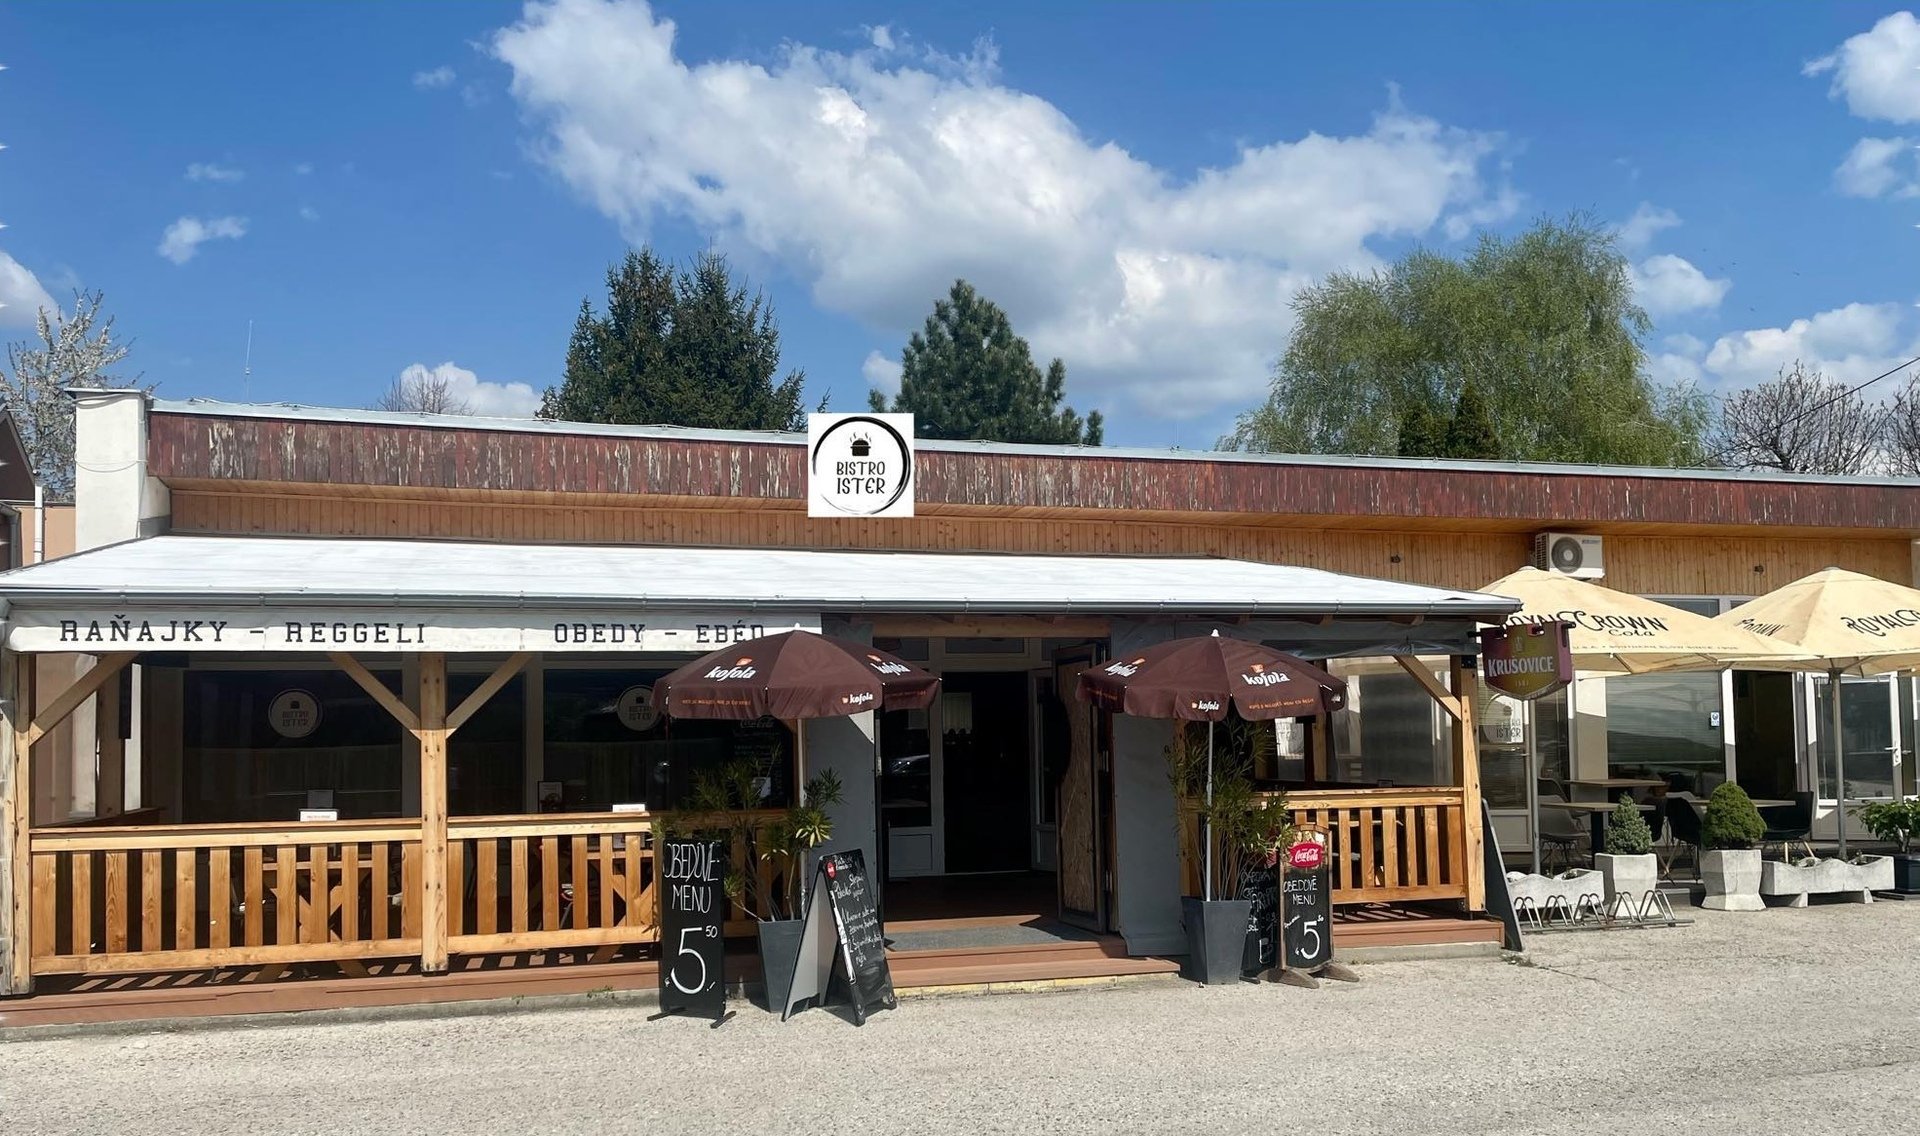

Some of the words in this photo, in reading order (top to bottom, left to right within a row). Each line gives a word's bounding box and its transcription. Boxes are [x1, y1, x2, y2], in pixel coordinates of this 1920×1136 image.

[836, 461, 886, 476] BISTRO
[836, 477, 886, 495] ISTER
[60, 614, 228, 642] RAŇAJKY
[285, 622, 425, 643] REGGELI
[1557, 610, 1669, 632] CROWN
[1840, 613, 1915, 637] ROYAL
[554, 623, 645, 643] OBEDY
[696, 619, 765, 643] EBÉD
[1609, 627, 1657, 638] Cola
[704, 665, 757, 682] kofola
[1241, 671, 1291, 687] kofola
[849, 692, 874, 705] kofola
[1198, 700, 1220, 713] kofola
[671, 884, 712, 913] MENU
[1293, 894, 1316, 906] MENU
